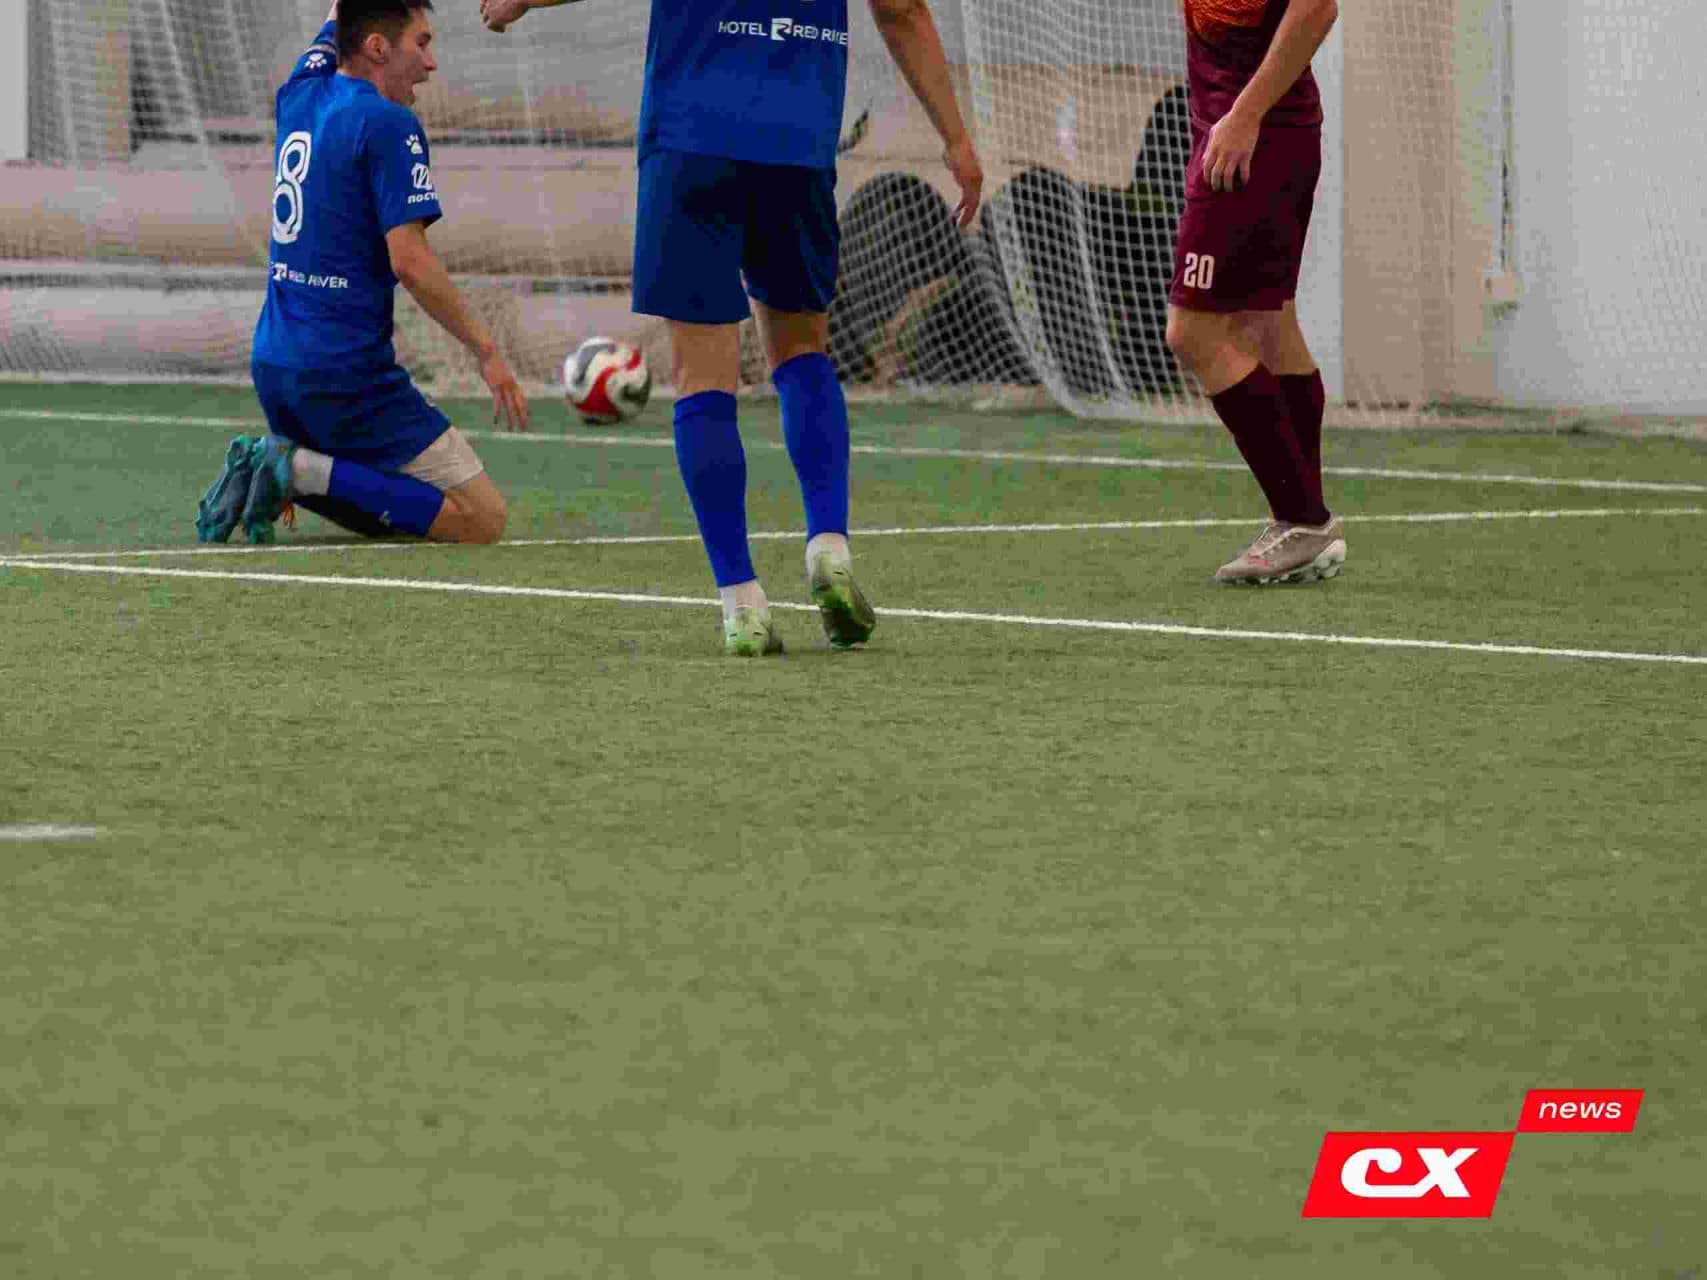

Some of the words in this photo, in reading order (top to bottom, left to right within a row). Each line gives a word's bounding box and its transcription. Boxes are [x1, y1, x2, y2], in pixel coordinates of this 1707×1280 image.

[717, 21, 768, 36] HOTEL
[793, 25, 819, 39] RED
[272, 131, 312, 244] 8
[307, 274, 348, 289] RIVER
[1183, 252, 1215, 290] 20
